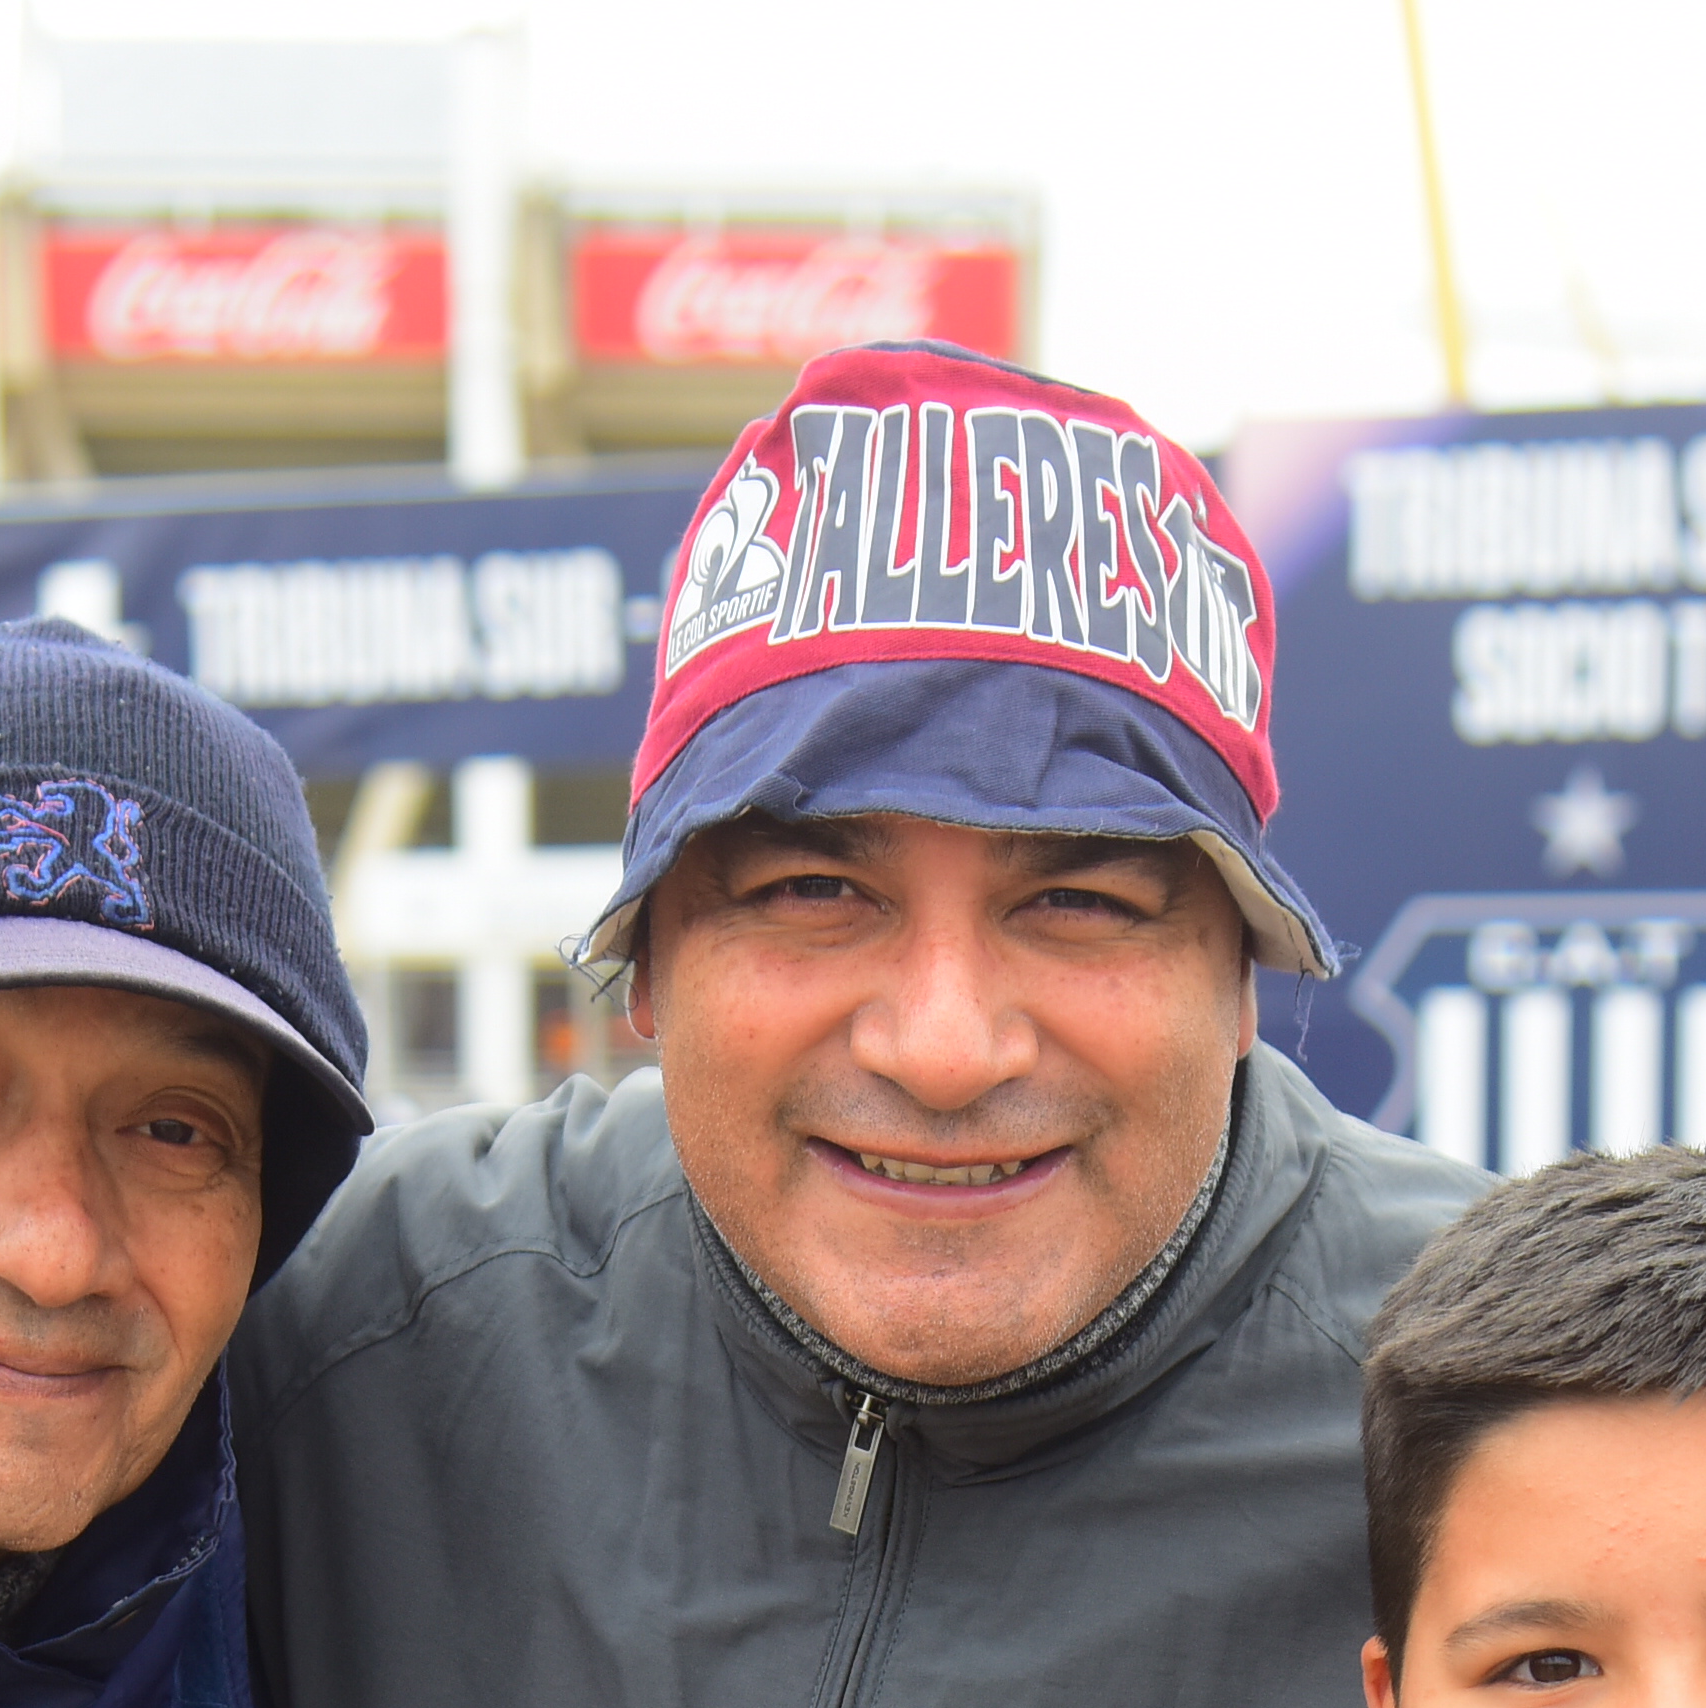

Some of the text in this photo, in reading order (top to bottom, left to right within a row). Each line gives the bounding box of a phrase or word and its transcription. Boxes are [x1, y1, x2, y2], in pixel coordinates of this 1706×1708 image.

[767, 402, 1173, 684] TALLERES
[1339, 437, 1680, 601] TRIBUNA
[177, 554, 475, 705] TRIBUNA
[473, 546, 624, 700] SUR
[671, 630, 684, 664] LE
[708, 581, 777, 632] SPORTIF
[843, 1461, 861, 1518] KEVINGSTON
